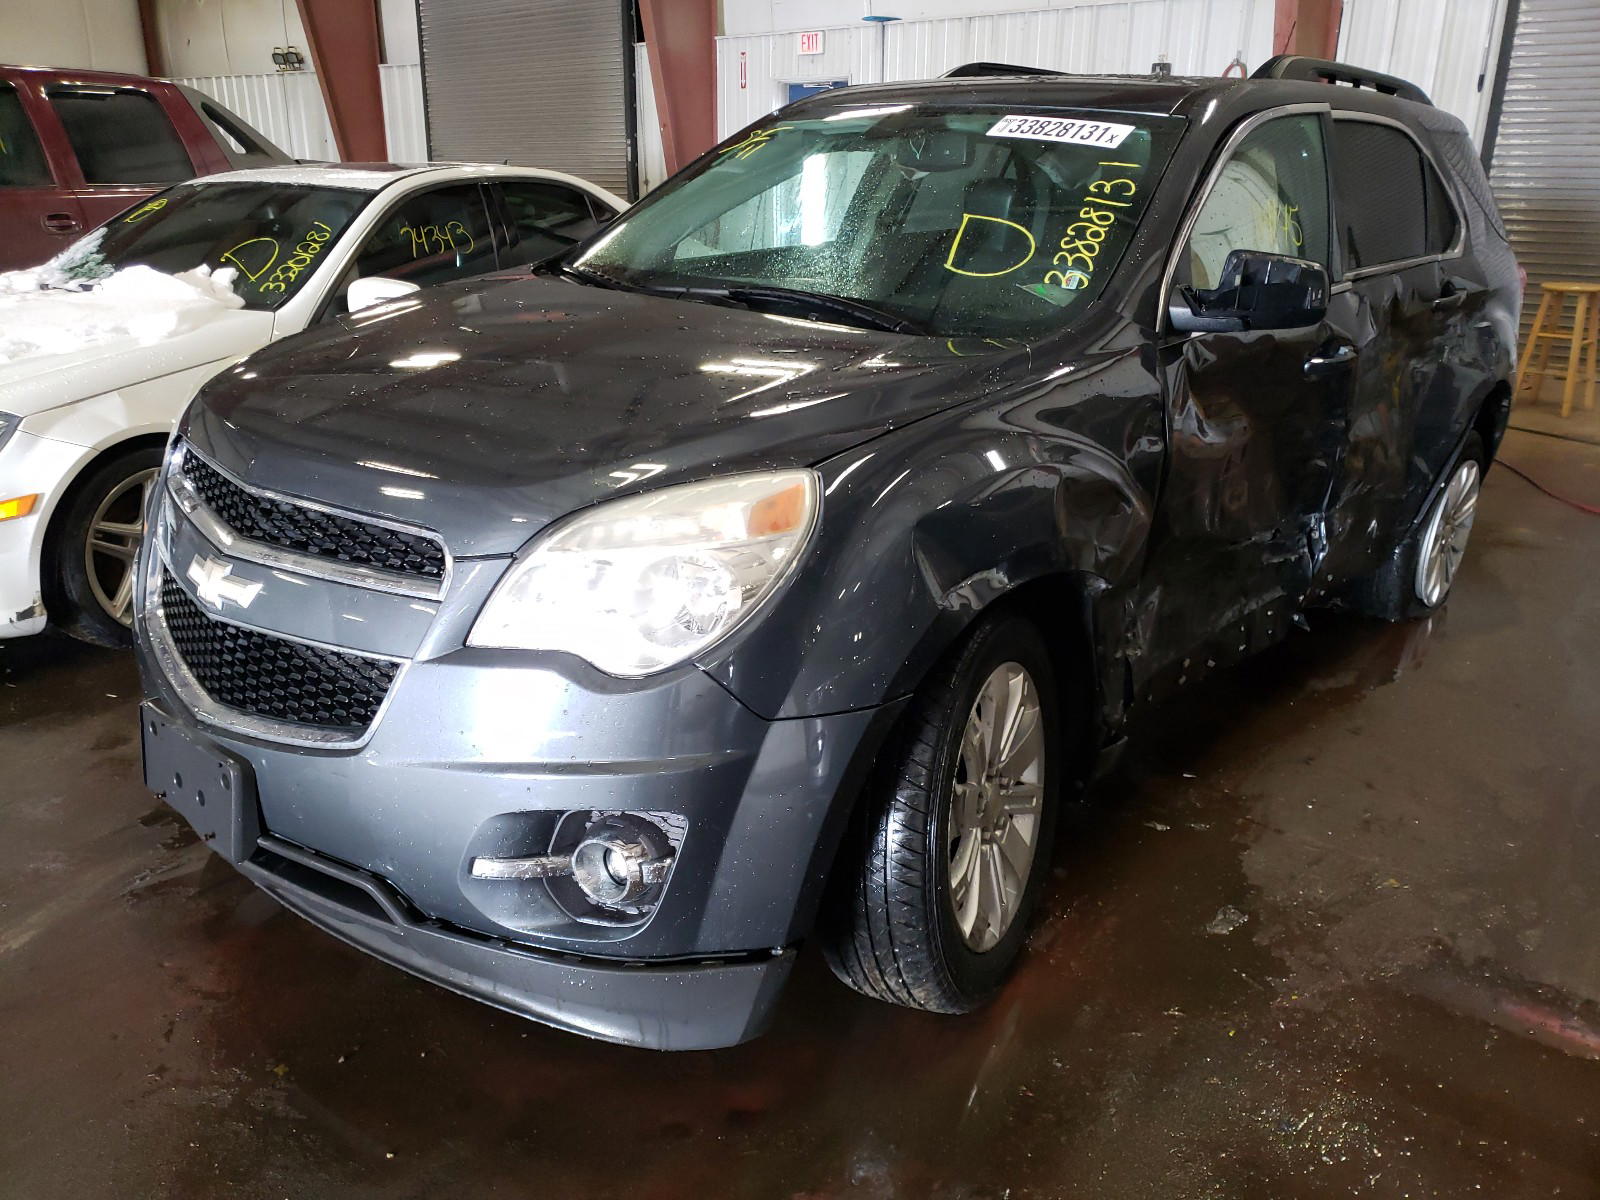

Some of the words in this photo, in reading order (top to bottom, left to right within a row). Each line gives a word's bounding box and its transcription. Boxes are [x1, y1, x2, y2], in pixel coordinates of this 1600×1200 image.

[801, 33, 819, 52] EXIT
[943, 213, 1036, 277] D
[1044, 161, 1142, 290] 33828131
[220, 237, 279, 282] D
